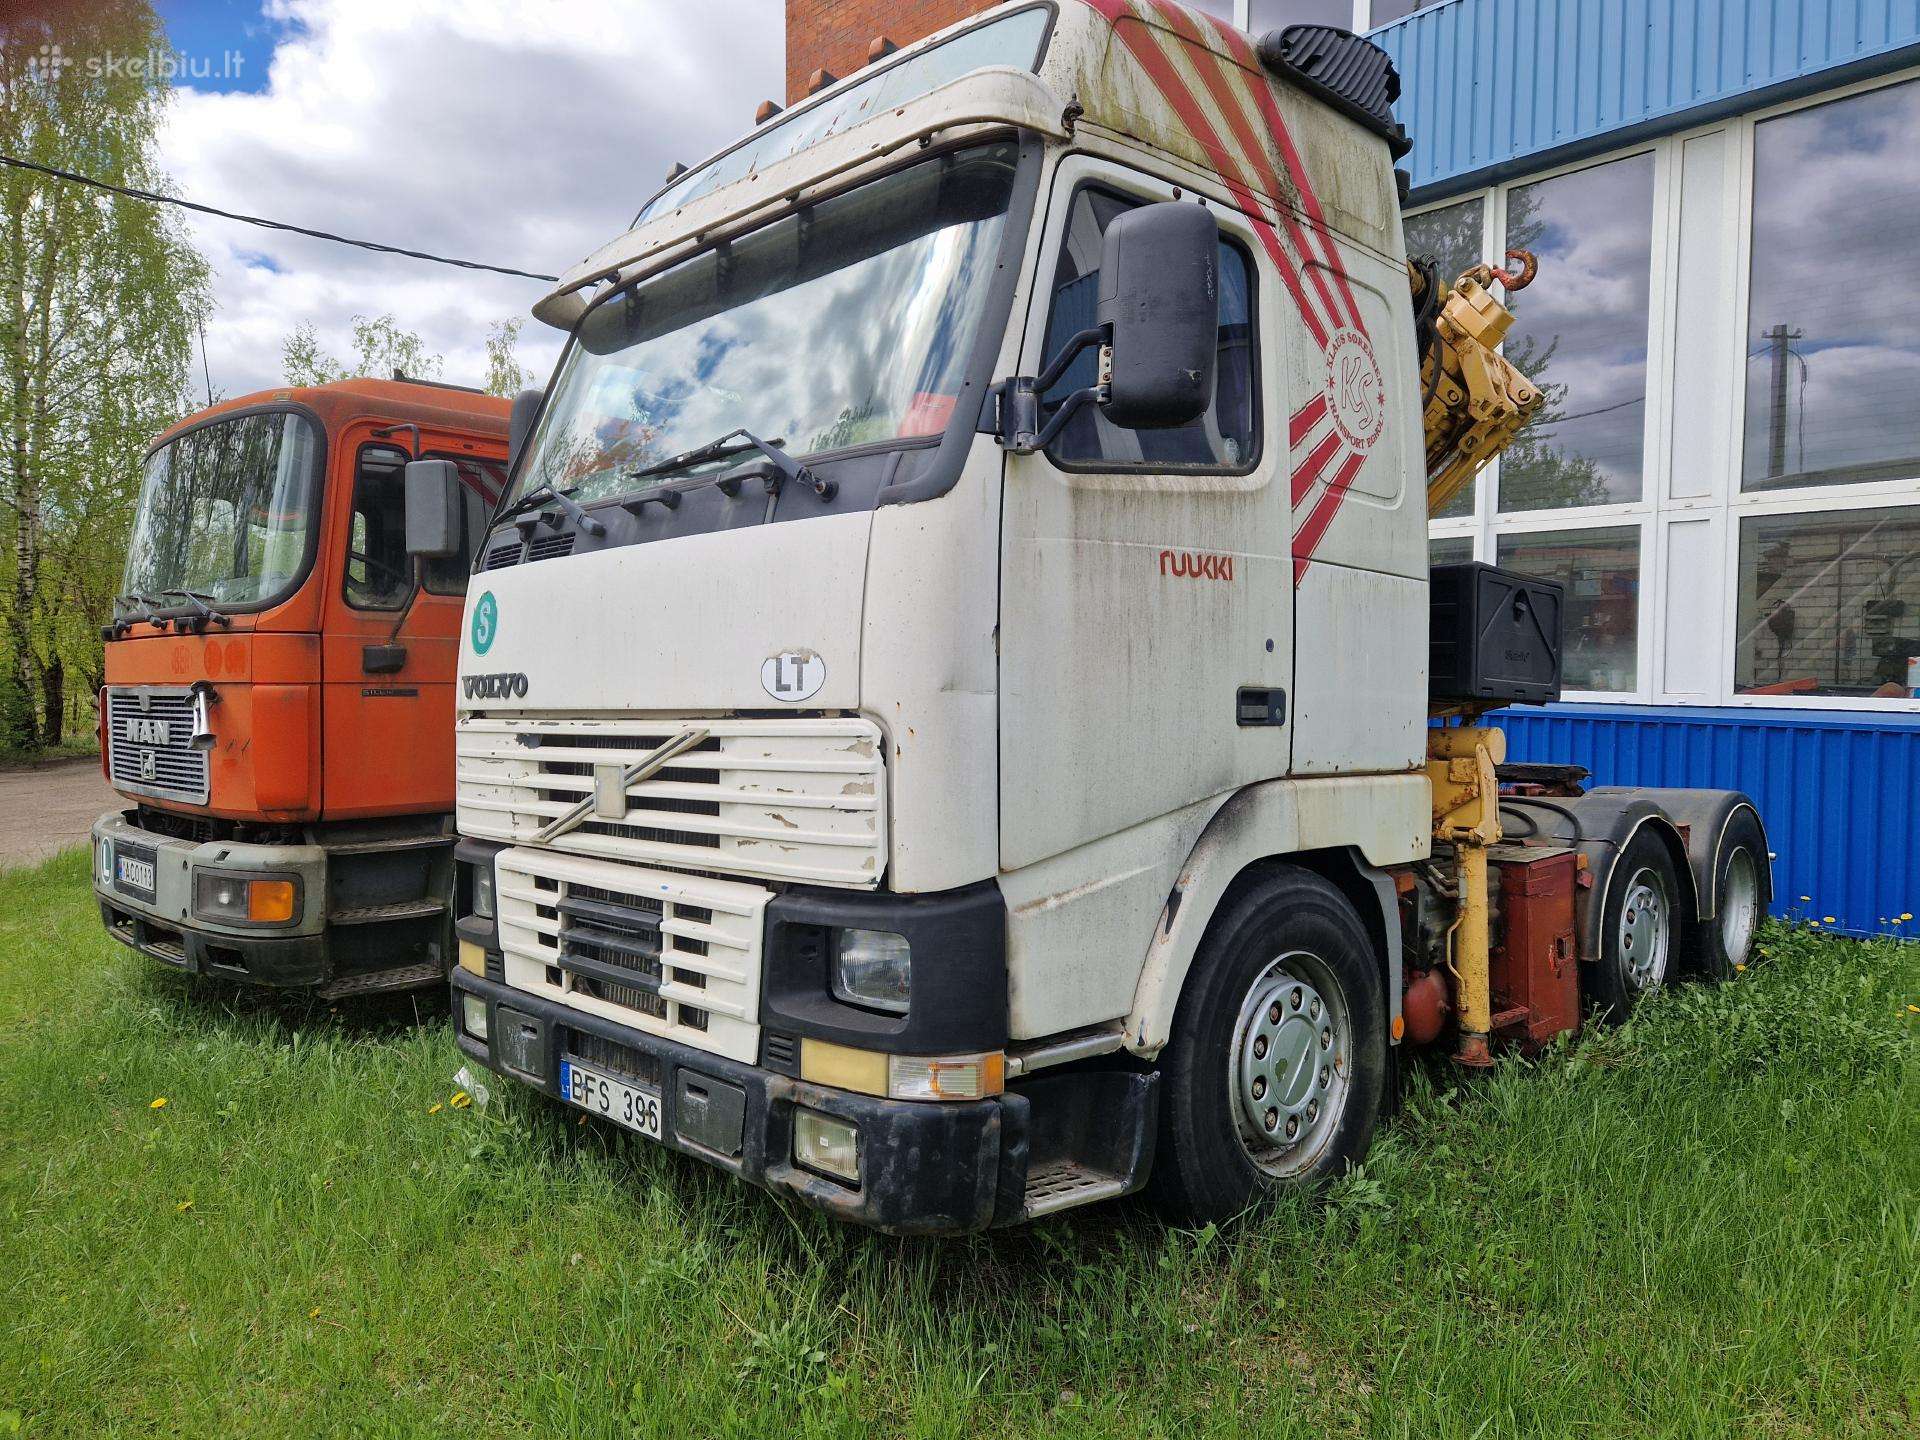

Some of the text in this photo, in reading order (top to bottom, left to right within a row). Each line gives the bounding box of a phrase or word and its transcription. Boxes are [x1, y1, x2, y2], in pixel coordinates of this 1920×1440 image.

[1326, 334, 1346, 370] KLAUS
[1341, 355, 1374, 430] KS
[1328, 394, 1366, 450] TRANSPORT
[477, 601, 491, 644] S
[461, 672, 529, 700] VOLVO
[775, 656, 810, 692] LT
[126, 719, 170, 745] MAN
[571, 1069, 658, 1134] BFS 396
